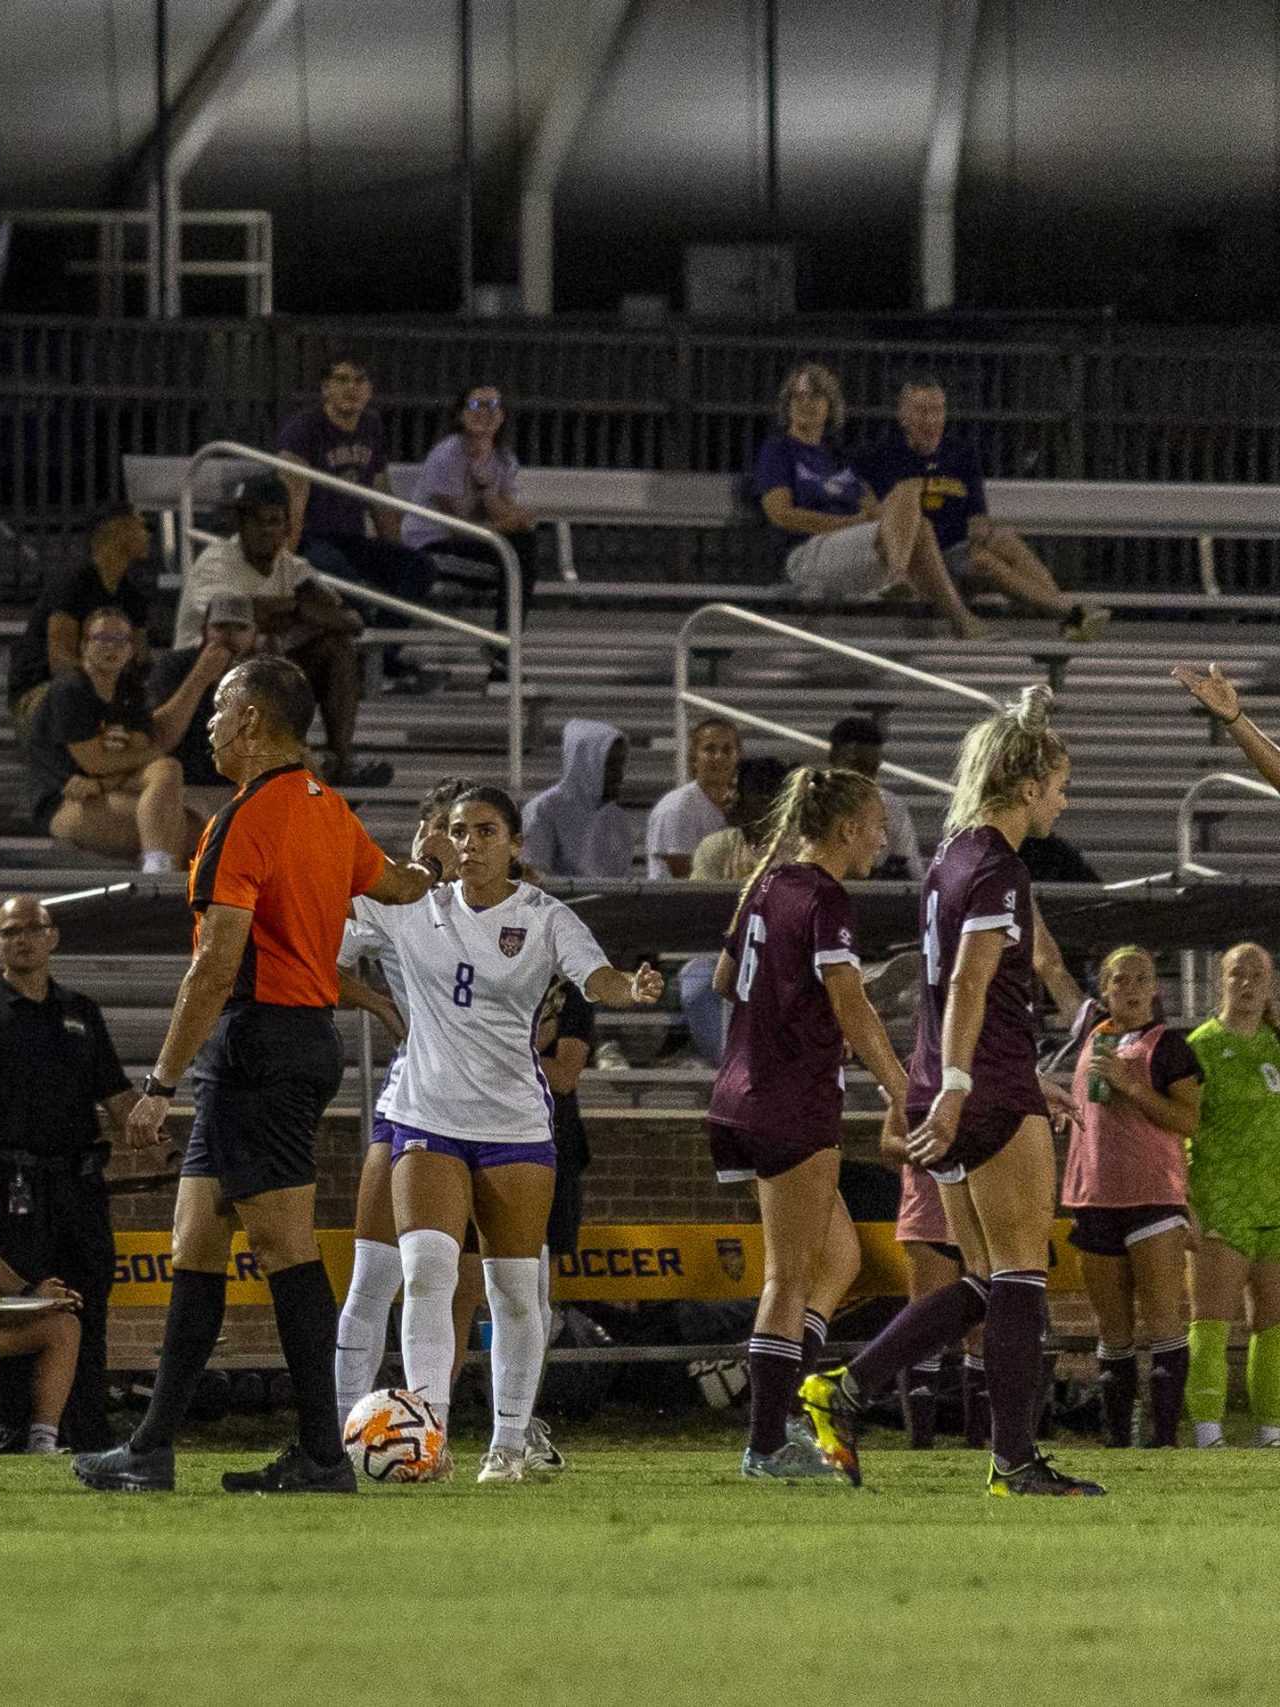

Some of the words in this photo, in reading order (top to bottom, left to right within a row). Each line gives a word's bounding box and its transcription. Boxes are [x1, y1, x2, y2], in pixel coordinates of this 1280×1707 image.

[736, 913, 768, 1002] 6
[453, 962, 475, 1009] 8
[112, 1252, 264, 1284] SOCR
[557, 1247, 685, 1278] OCCER
